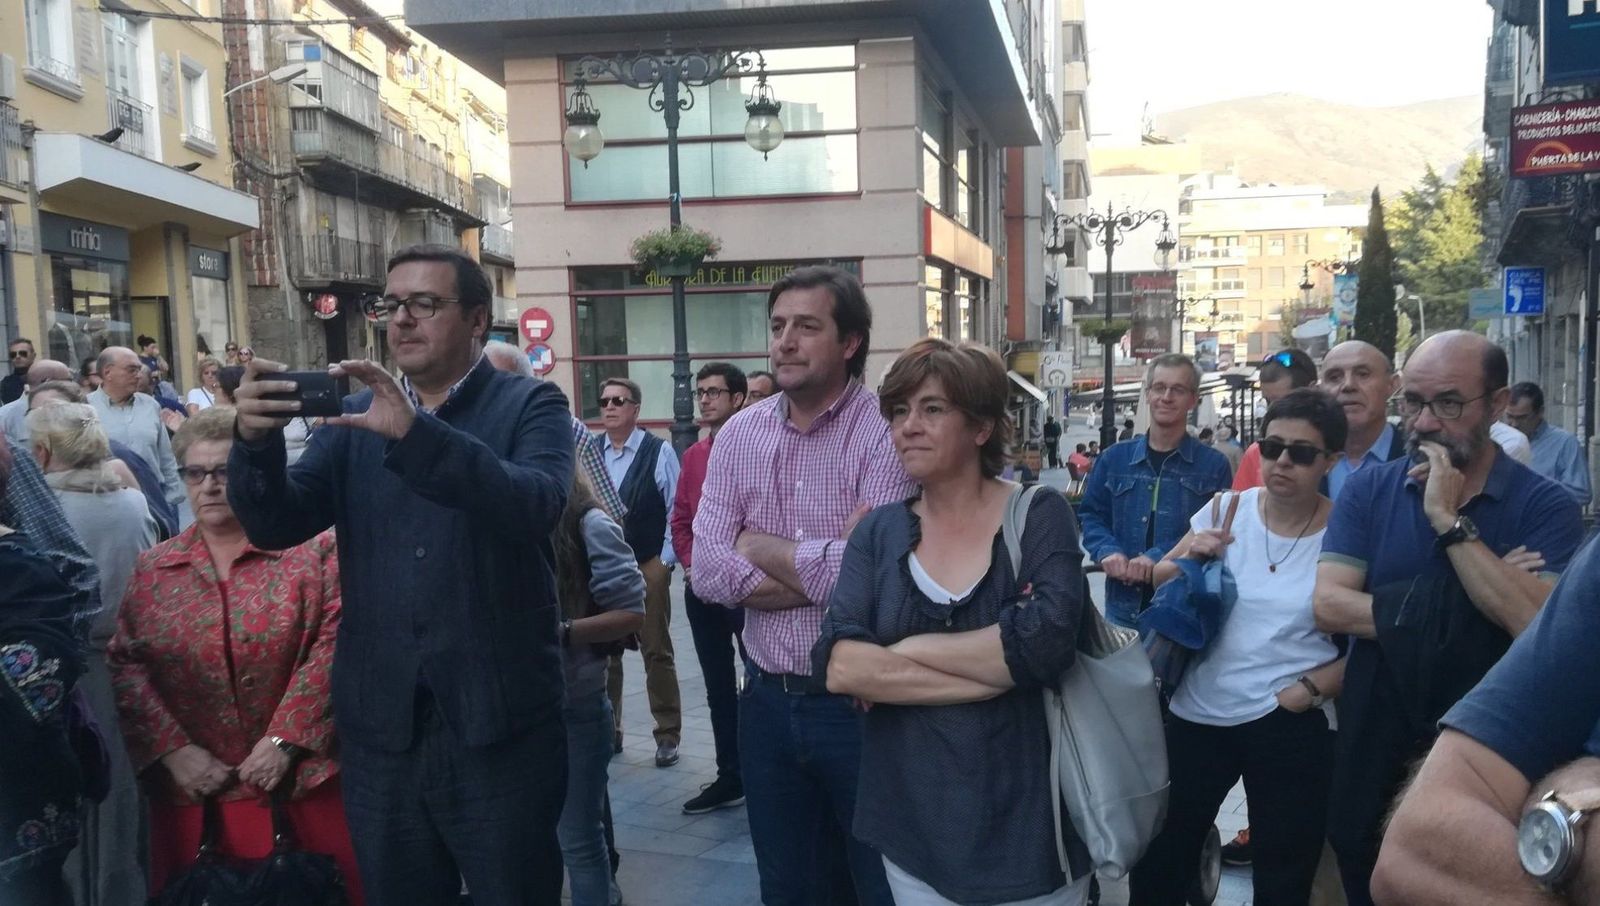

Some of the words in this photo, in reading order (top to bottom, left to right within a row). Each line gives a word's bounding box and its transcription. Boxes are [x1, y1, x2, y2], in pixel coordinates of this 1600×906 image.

[1517, 124, 1561, 140] PRODUCTOS
[1531, 153, 1567, 167] PUERTA
[1567, 151, 1580, 164] DE
[1581, 150, 1594, 162] LA
[198, 251, 218, 272] store
[645, 268, 704, 288] AURRA
[710, 267, 727, 285] DE
[732, 266, 745, 284] LA
